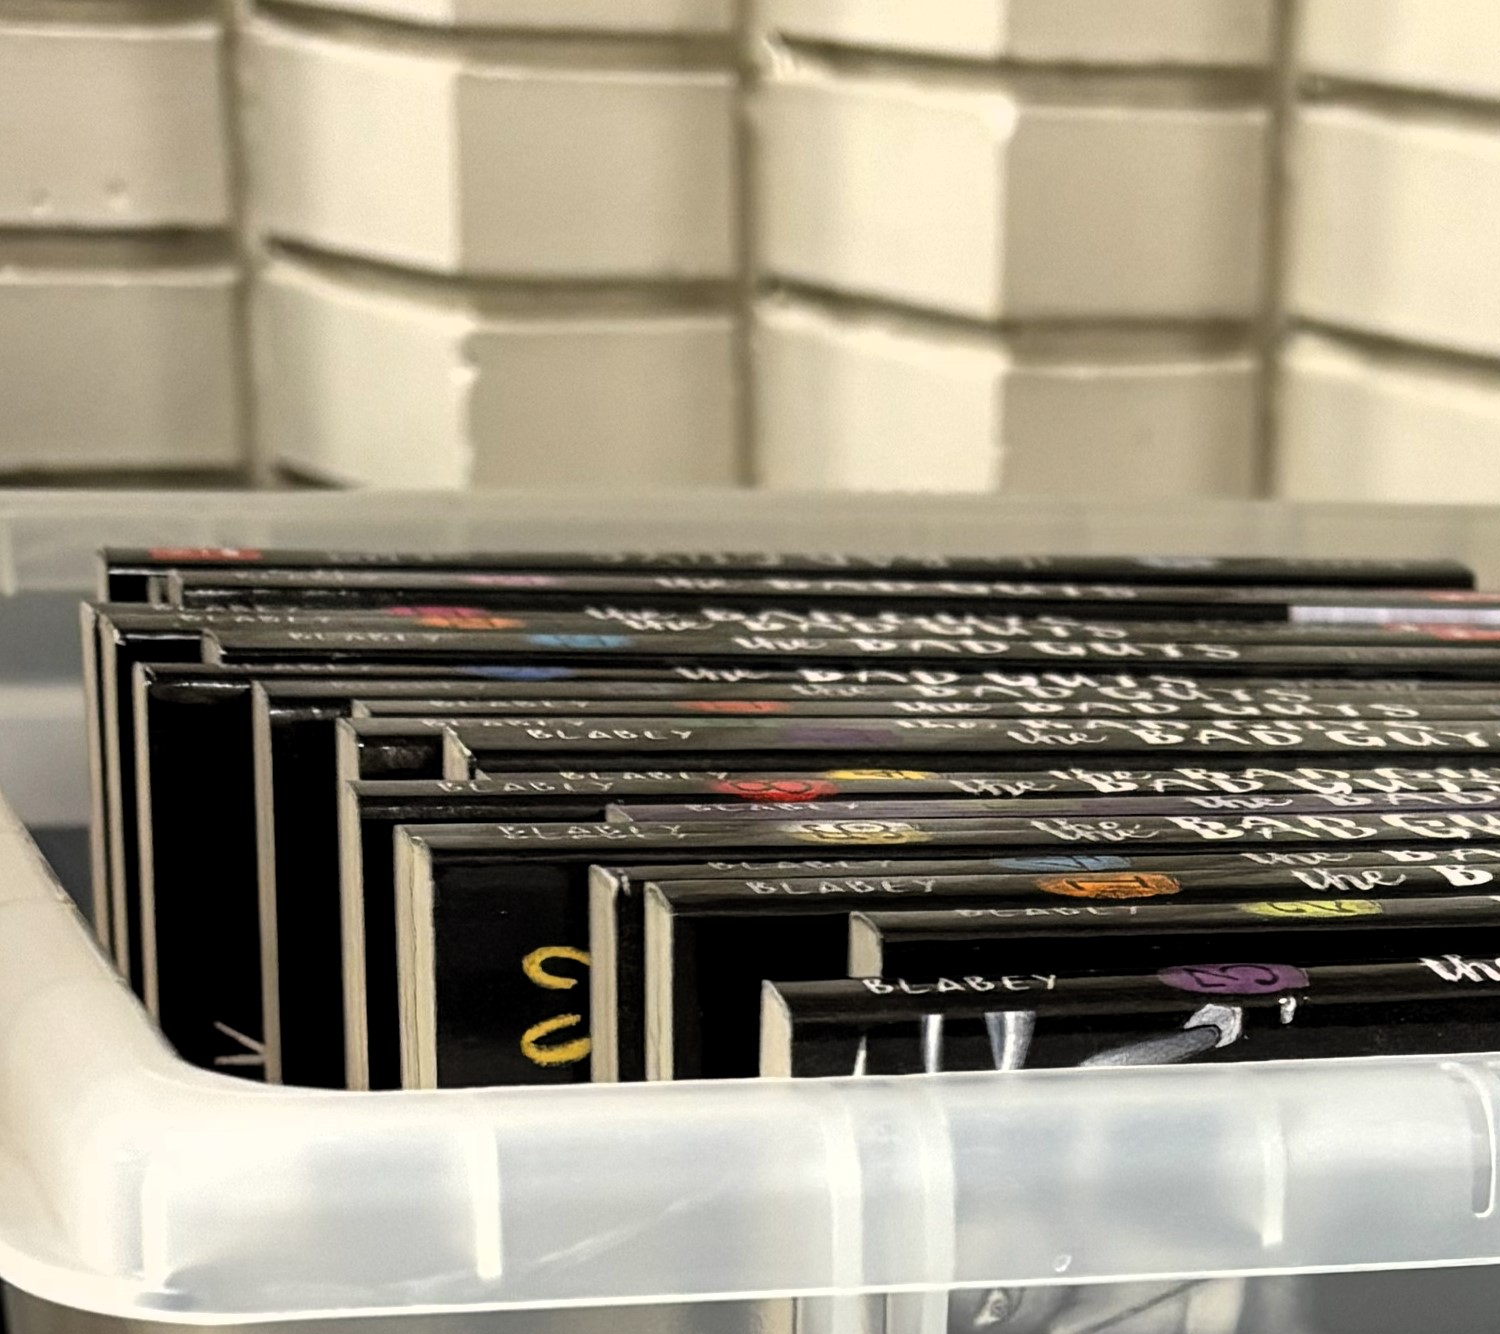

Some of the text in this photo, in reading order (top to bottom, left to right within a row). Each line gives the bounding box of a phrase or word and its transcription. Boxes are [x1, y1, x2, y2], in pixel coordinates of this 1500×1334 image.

[1130, 729, 1301, 746] BAD
[1291, 866, 1406, 891] the
[861, 974, 1058, 995] BLABEY
